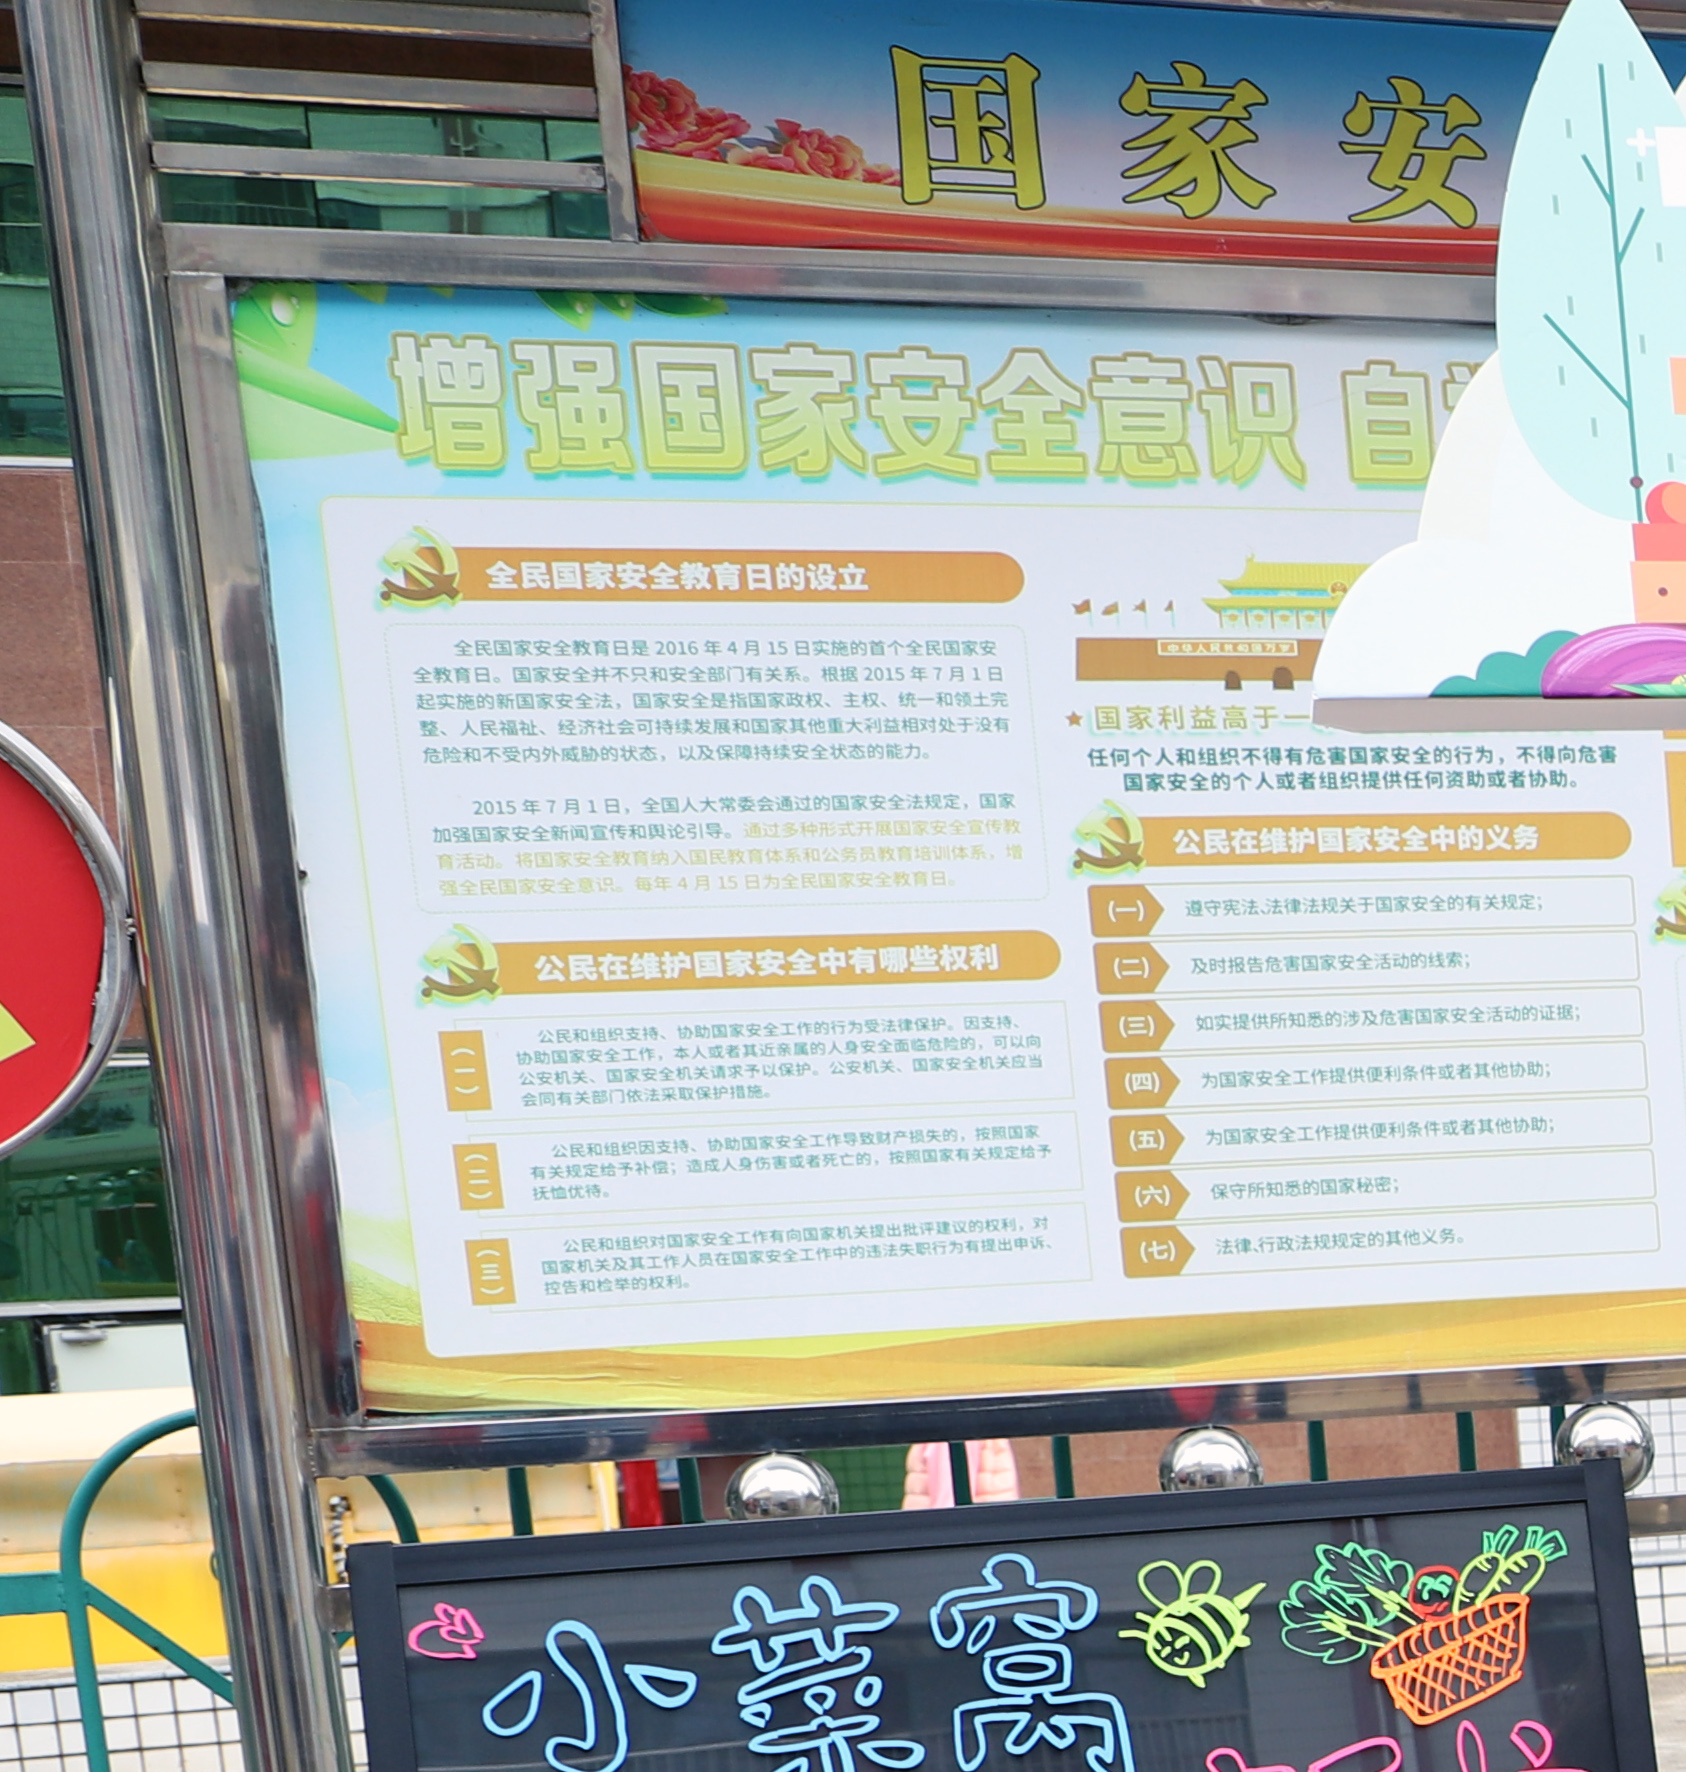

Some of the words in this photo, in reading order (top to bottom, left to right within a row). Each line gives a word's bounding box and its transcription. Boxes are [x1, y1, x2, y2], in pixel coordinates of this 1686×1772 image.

[888, 43, 1490, 230] 国家安
[388, 332, 1307, 487] 增强国家安全意识
[485, 561, 870, 592] 全民国家安全教育日的设立
[1093, 704, 1312, 731] 国家利益高于一
[1086, 745, 1618, 768] 任何个人和组织不得有危害国家安全的行为，不得向危害
[1122, 769, 1579, 793] 国家安全的个人或者组织提供任何资助或者协助。
[1172, 823, 1540, 857] 公民在维护国家安全中的义务
[533, 943, 1000, 984] 公民在维护国家安全中有哪些权利
[543, 1273, 691, 1297] 控告和检举的权利。
